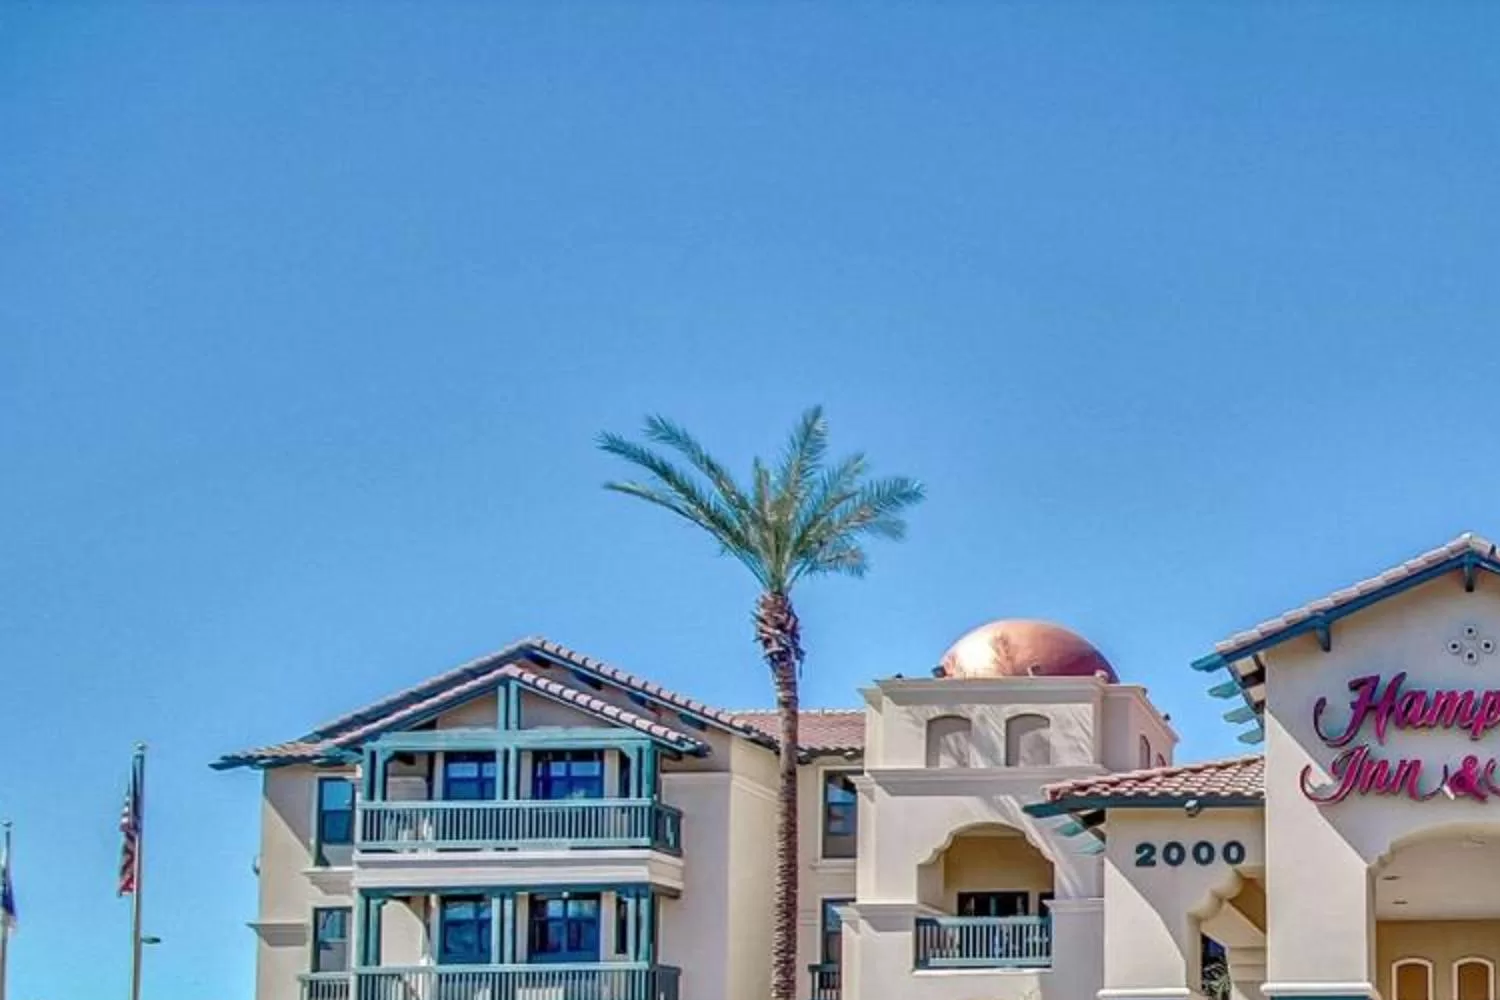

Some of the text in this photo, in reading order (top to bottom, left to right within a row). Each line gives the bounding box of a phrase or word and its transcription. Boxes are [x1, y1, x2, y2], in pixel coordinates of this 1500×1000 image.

[1300, 744, 1448, 804] Inn
[1449, 755, 1488, 803] &
[1135, 840, 1246, 868] 2000
